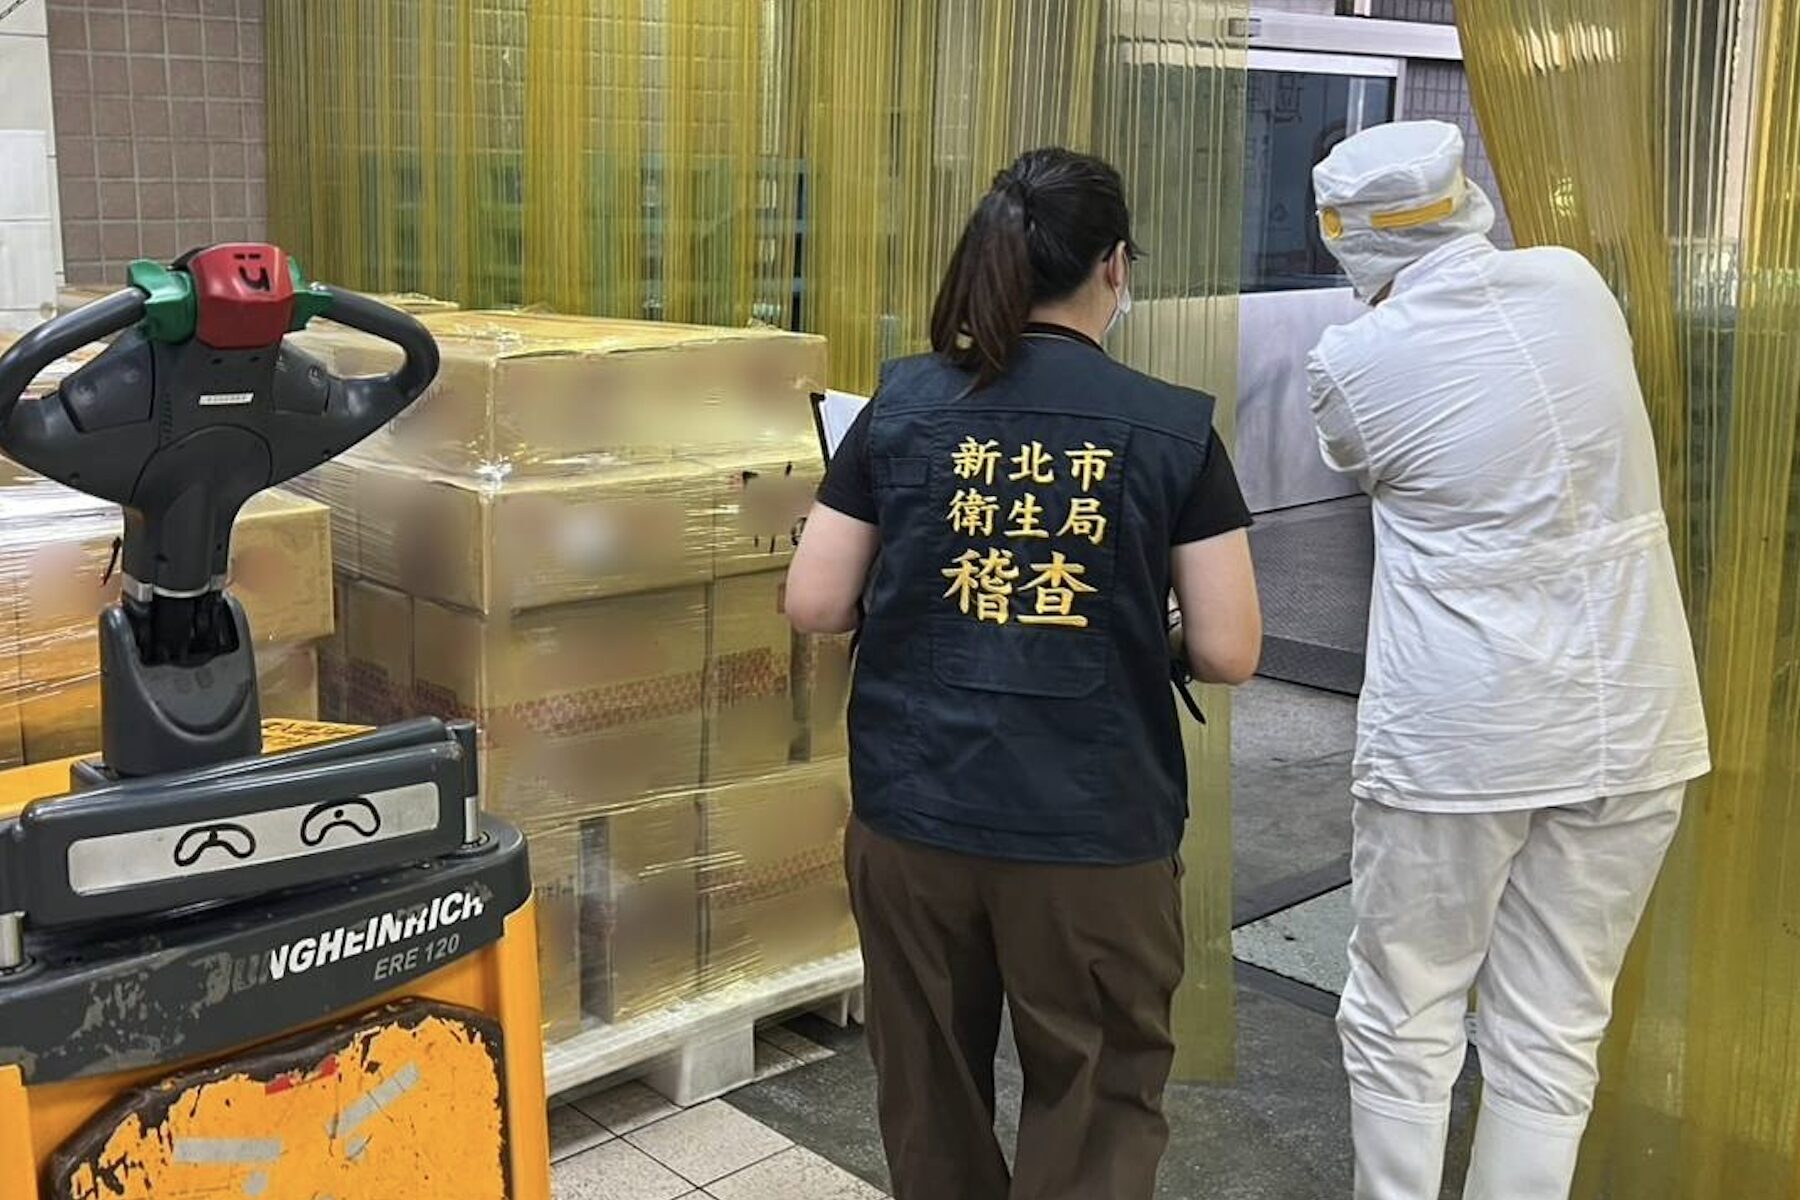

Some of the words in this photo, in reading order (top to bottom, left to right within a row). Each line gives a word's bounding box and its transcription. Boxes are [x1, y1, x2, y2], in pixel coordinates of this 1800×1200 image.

[951, 436, 1113, 492] 新北市
[946, 488, 1107, 544] 衛生局
[941, 547, 1098, 628] 稽查
[374, 948, 418, 981] ERE
[424, 932, 460, 961] 120
